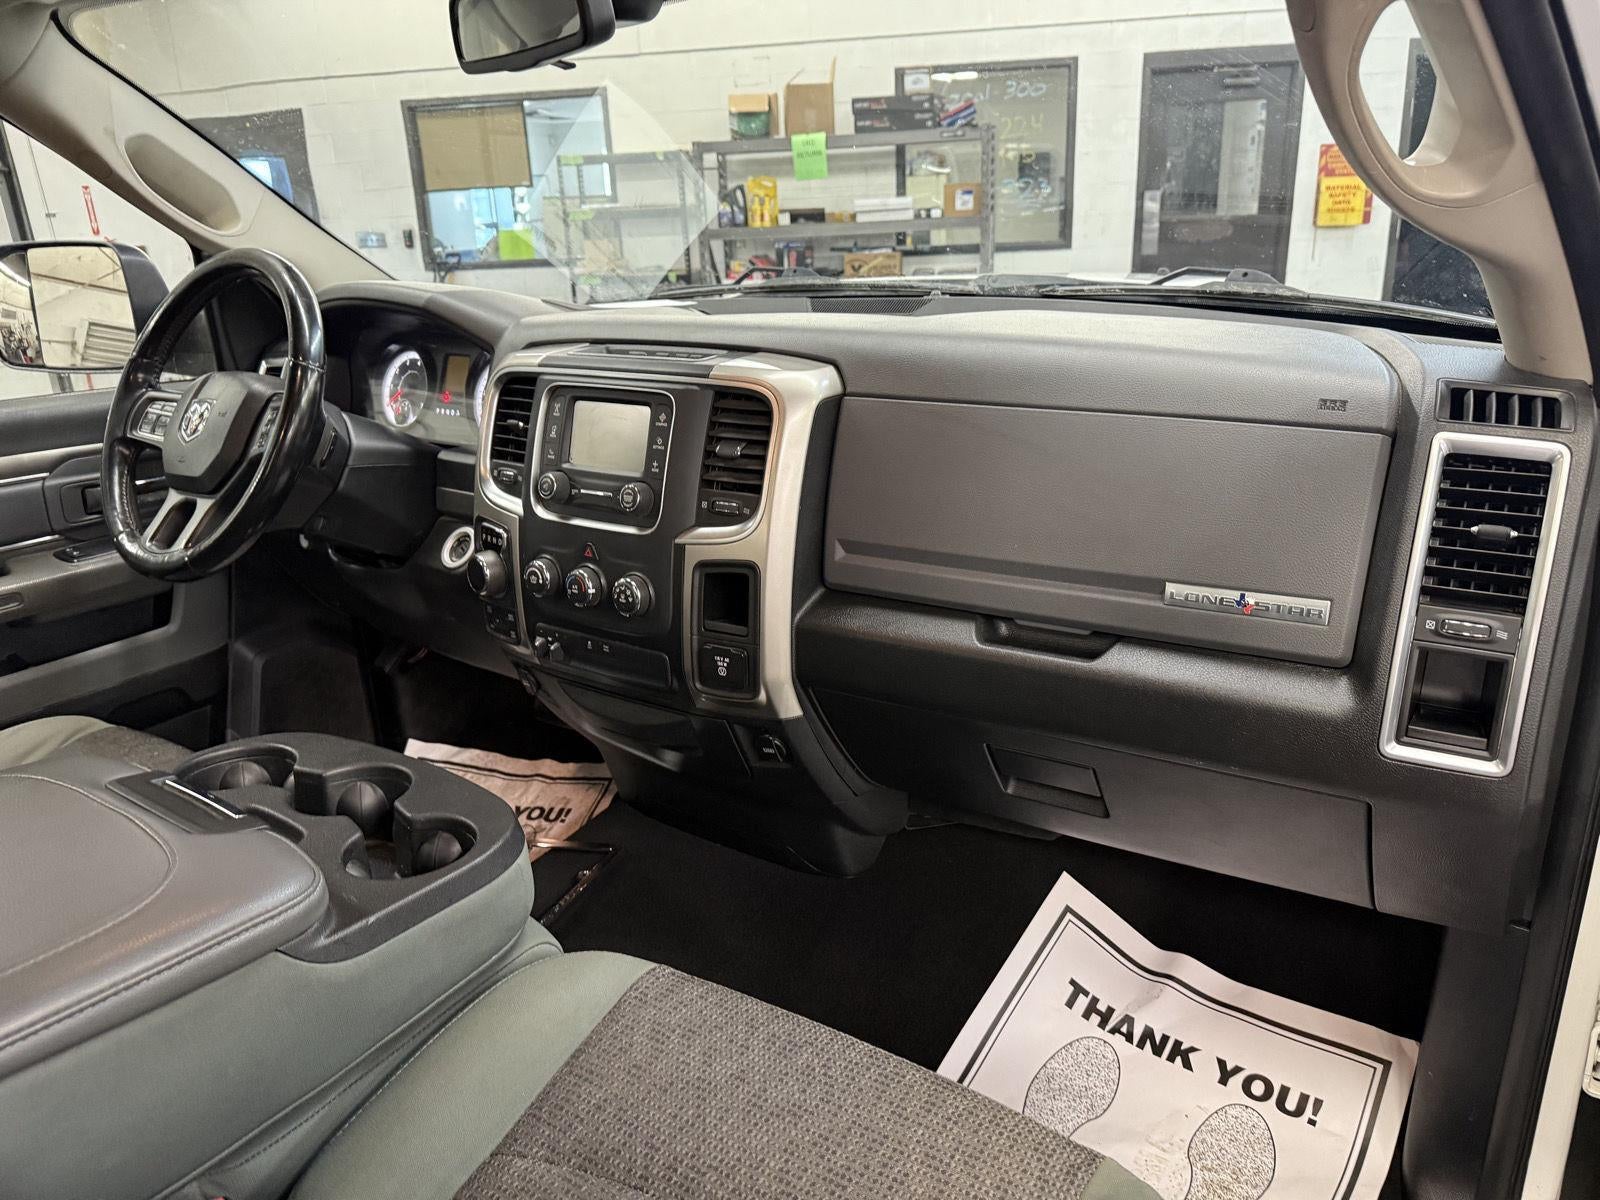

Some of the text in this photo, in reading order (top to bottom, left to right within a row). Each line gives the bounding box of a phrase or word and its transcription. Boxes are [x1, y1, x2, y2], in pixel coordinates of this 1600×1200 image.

[1004, 80, 1048, 100] 300
[1169, 591, 1325, 619] LONE STAR
[515, 805, 573, 824] YOU!
[1064, 977, 1324, 1128] THANK YOU!
